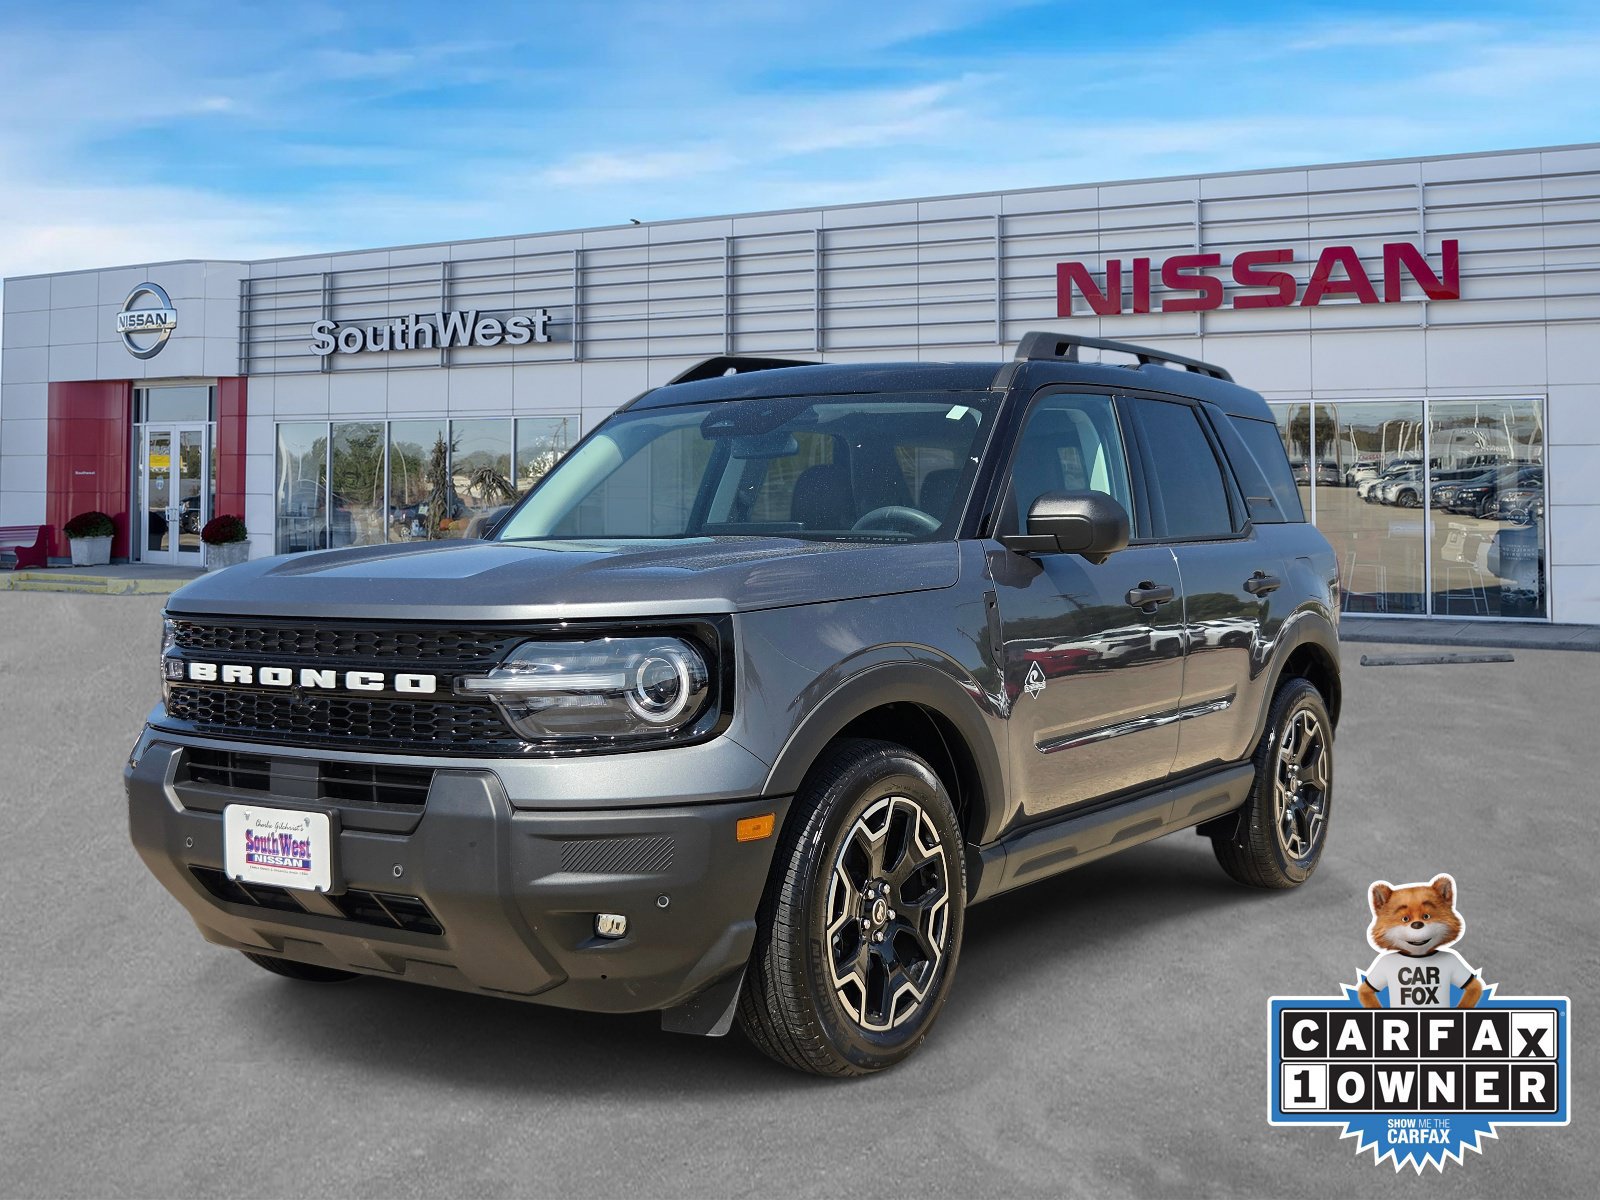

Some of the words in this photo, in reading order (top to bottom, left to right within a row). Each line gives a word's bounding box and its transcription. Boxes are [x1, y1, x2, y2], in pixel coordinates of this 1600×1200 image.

[1056, 239, 1460, 317] NISSAN
[119, 312, 167, 328] NISSAN
[309, 309, 550, 355] SouthWest
[189, 662, 437, 694] BRONCO
[254, 854, 303, 867] NISSAN
